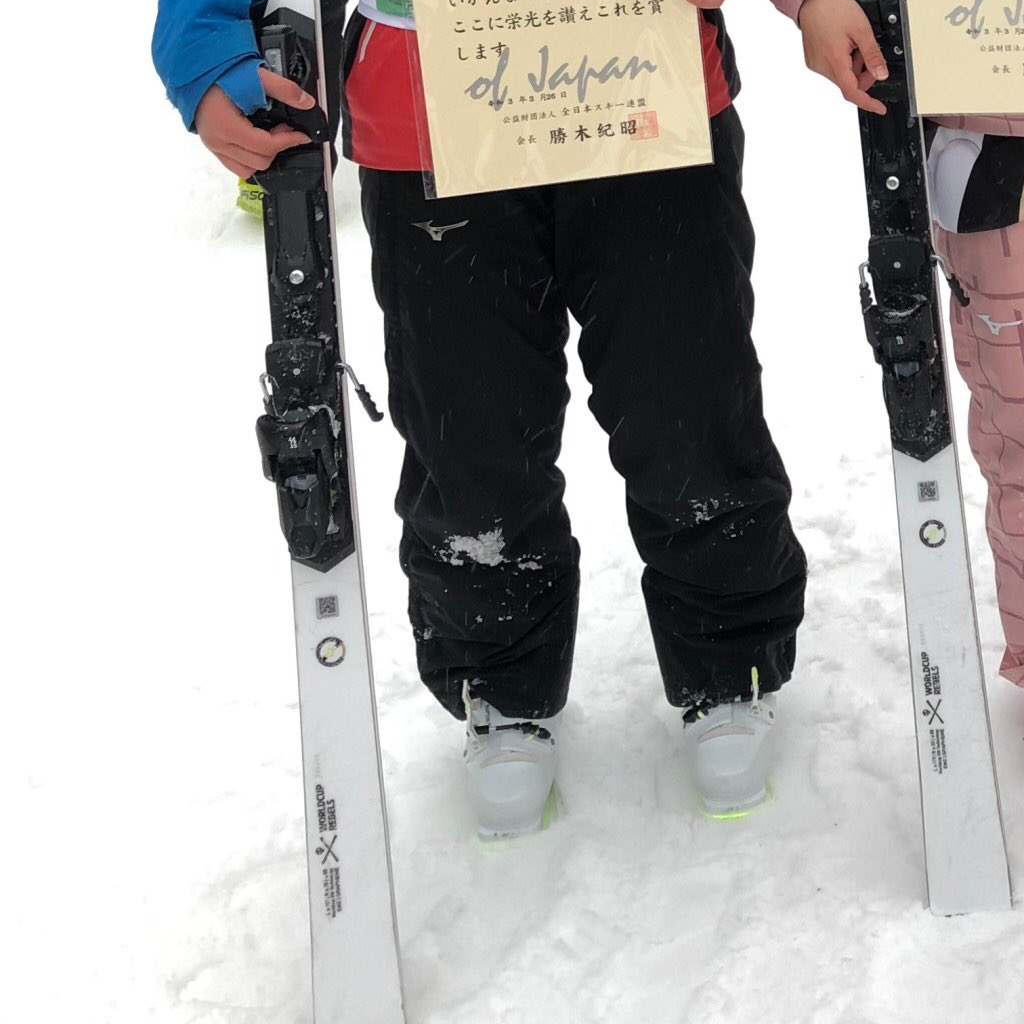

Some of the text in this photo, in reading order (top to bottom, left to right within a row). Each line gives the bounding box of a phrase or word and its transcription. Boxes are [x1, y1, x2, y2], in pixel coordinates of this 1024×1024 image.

[457, 41, 507, 61] します
[464, 45, 657, 111] of Japan
[921, 652, 932, 696] WORLDCUP
[931, 666, 942, 695] REBELS
[316, 784, 327, 833] WORLDCUP
[326, 799, 337, 831] REBELS
